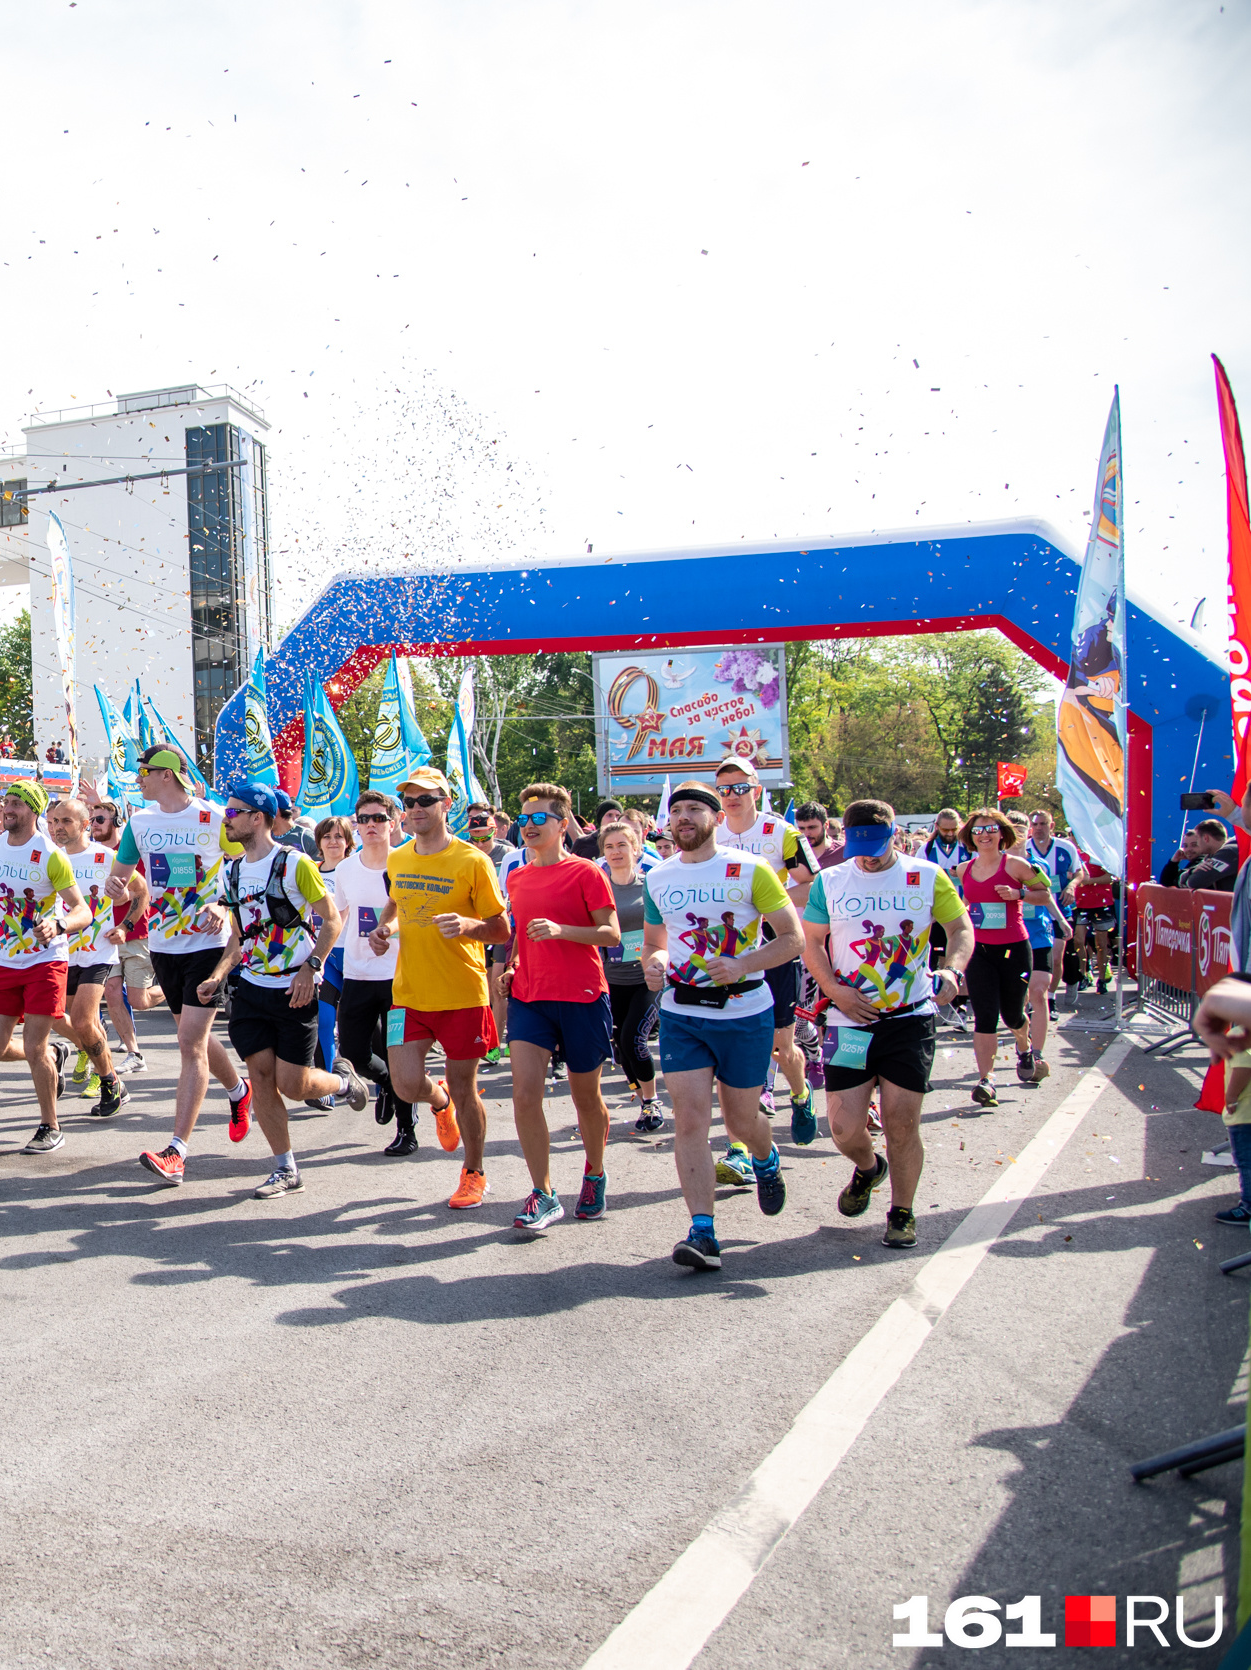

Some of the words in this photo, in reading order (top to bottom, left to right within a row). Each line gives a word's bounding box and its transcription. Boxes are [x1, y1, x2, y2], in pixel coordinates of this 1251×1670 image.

[669, 692, 719, 719] Спасибо
[687, 713, 701, 726] за
[703, 696, 745, 721] чистое
[721, 703, 756, 727] небо!
[647, 735, 706, 760] МАЯ
[172, 866, 194, 875] 01855
[841, 1042, 866, 1054] 02519
